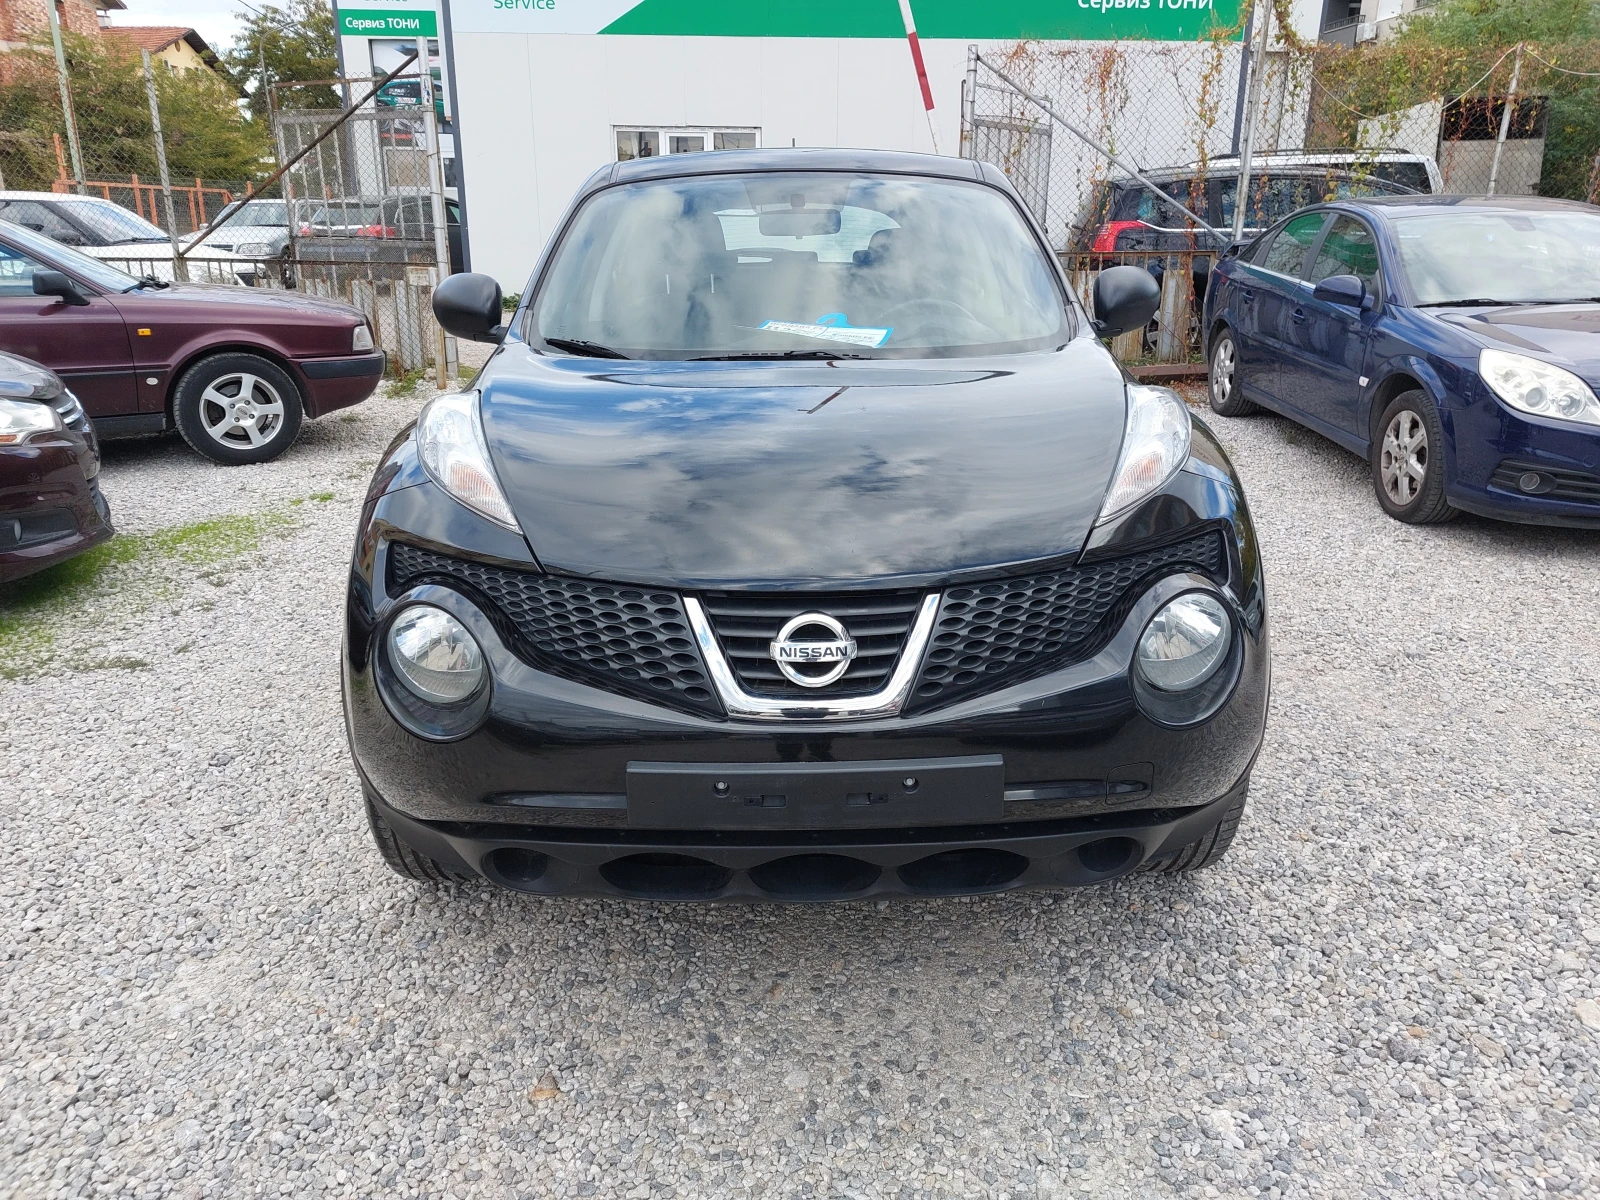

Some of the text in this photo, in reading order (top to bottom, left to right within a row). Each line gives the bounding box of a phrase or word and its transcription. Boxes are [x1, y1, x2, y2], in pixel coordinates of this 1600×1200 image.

[345, 17, 419, 30] Сервиз ТОНИ
[780, 646, 848, 658] NISSAN
